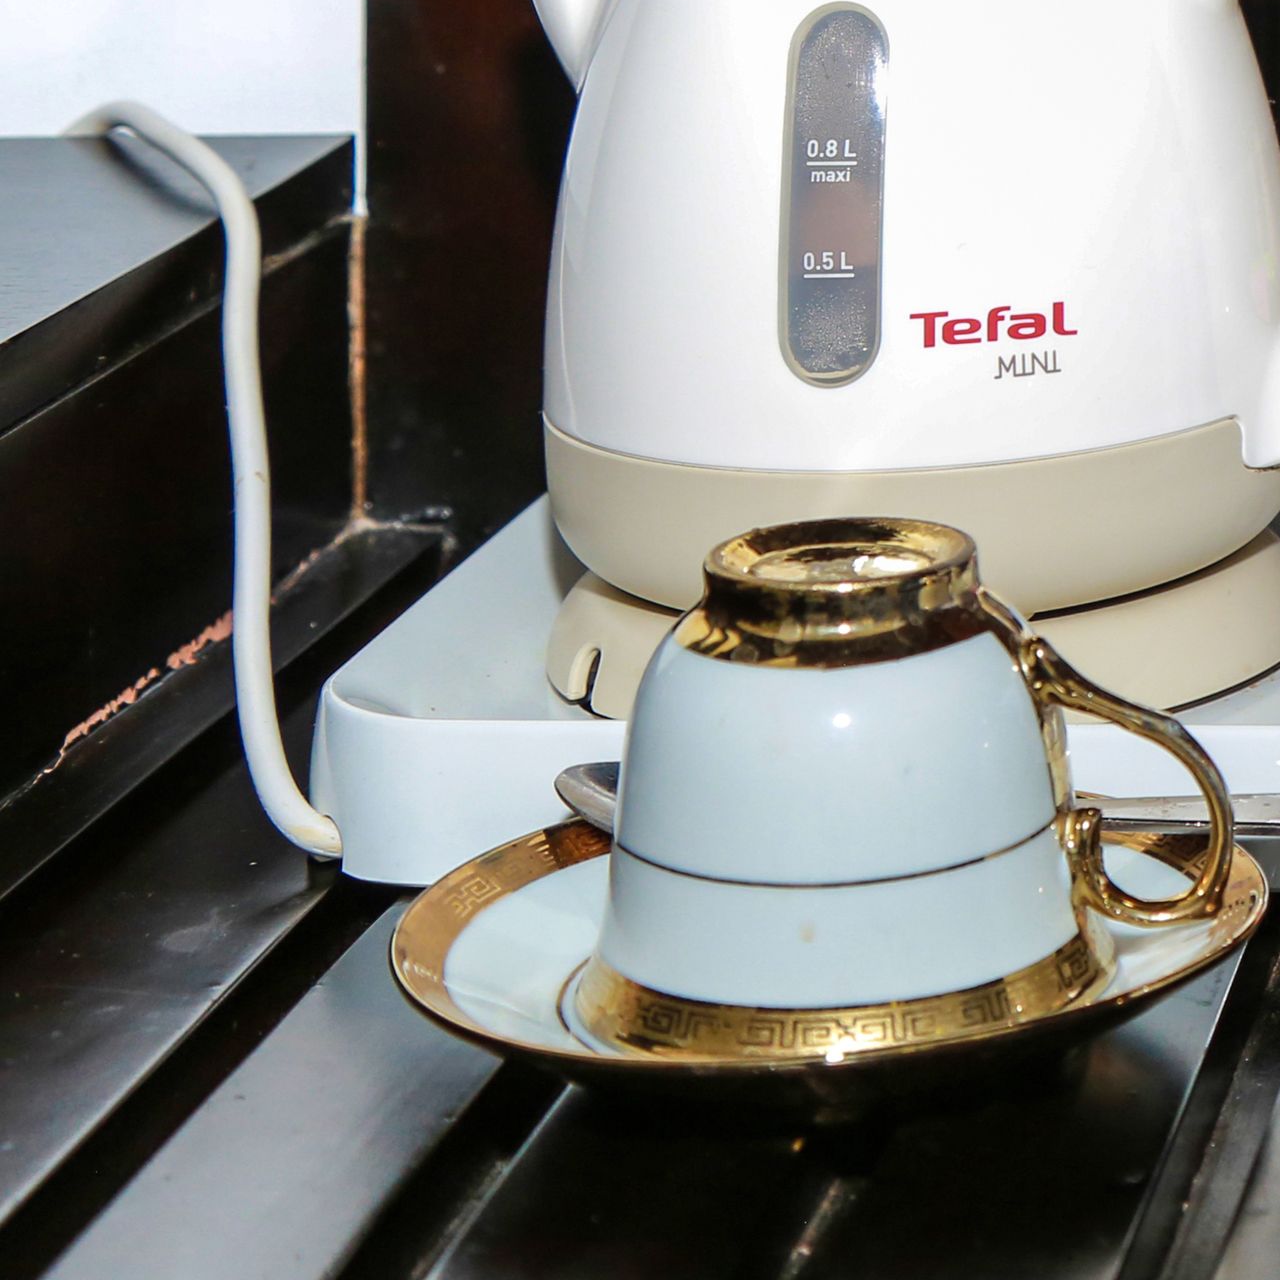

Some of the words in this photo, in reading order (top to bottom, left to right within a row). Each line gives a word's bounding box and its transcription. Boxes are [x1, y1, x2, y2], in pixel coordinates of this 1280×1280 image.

[807, 140, 837, 158] 0.8
[844, 140, 857, 157] L
[811, 168, 851, 183] maxi
[803, 252, 833, 271] 0.5
[840, 252, 854, 270] L
[910, 302, 1078, 348] Tefal
[994, 350, 1062, 379] MINI
